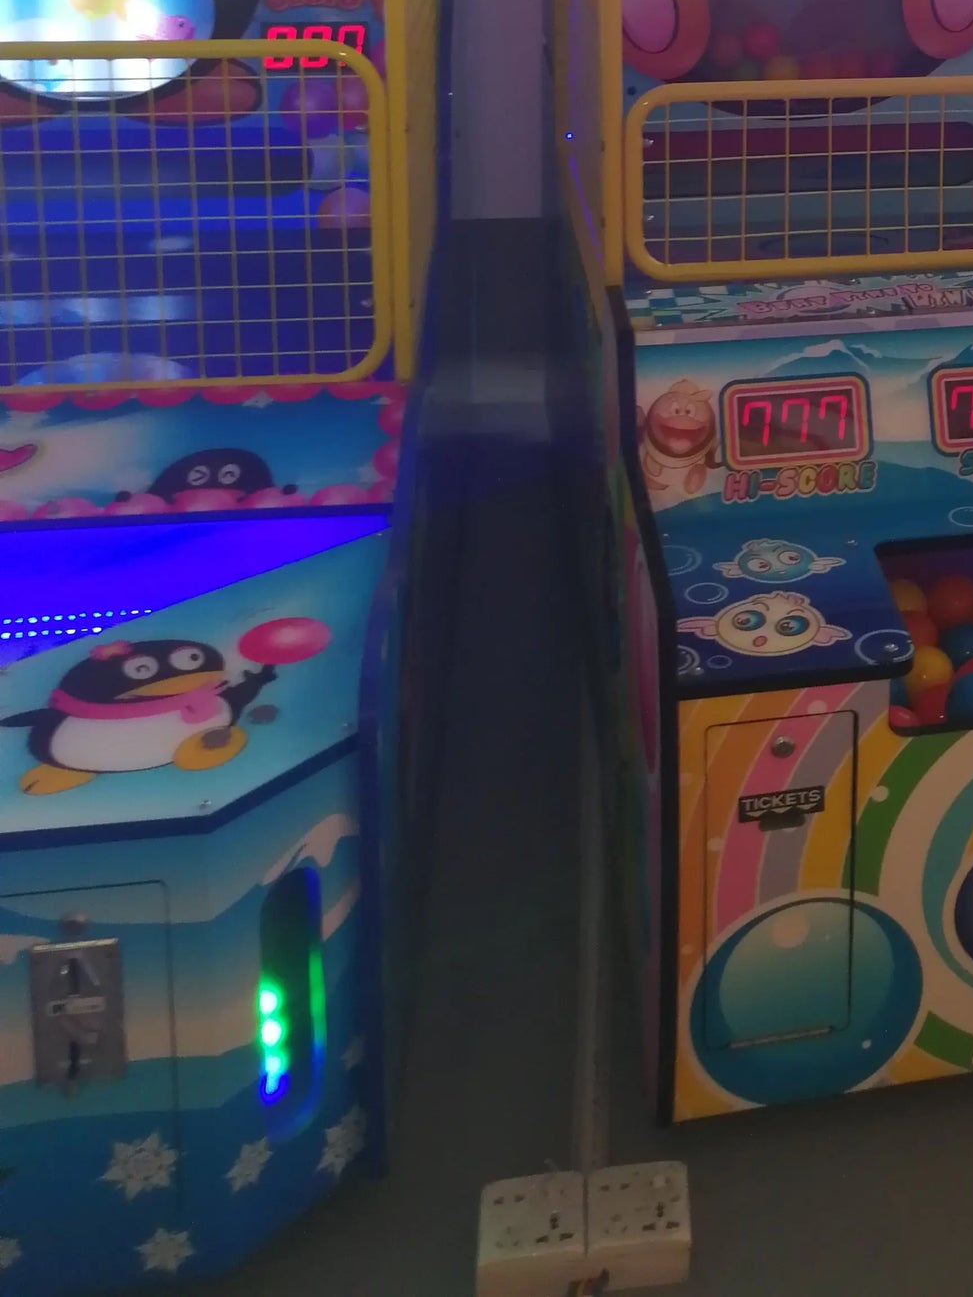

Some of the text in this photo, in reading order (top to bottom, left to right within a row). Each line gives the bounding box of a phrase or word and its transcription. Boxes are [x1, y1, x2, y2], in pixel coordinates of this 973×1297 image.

[742, 394, 847, 446] 777
[722, 460, 877, 502] HI-SCORE
[742, 789, 821, 811] TICKETS
